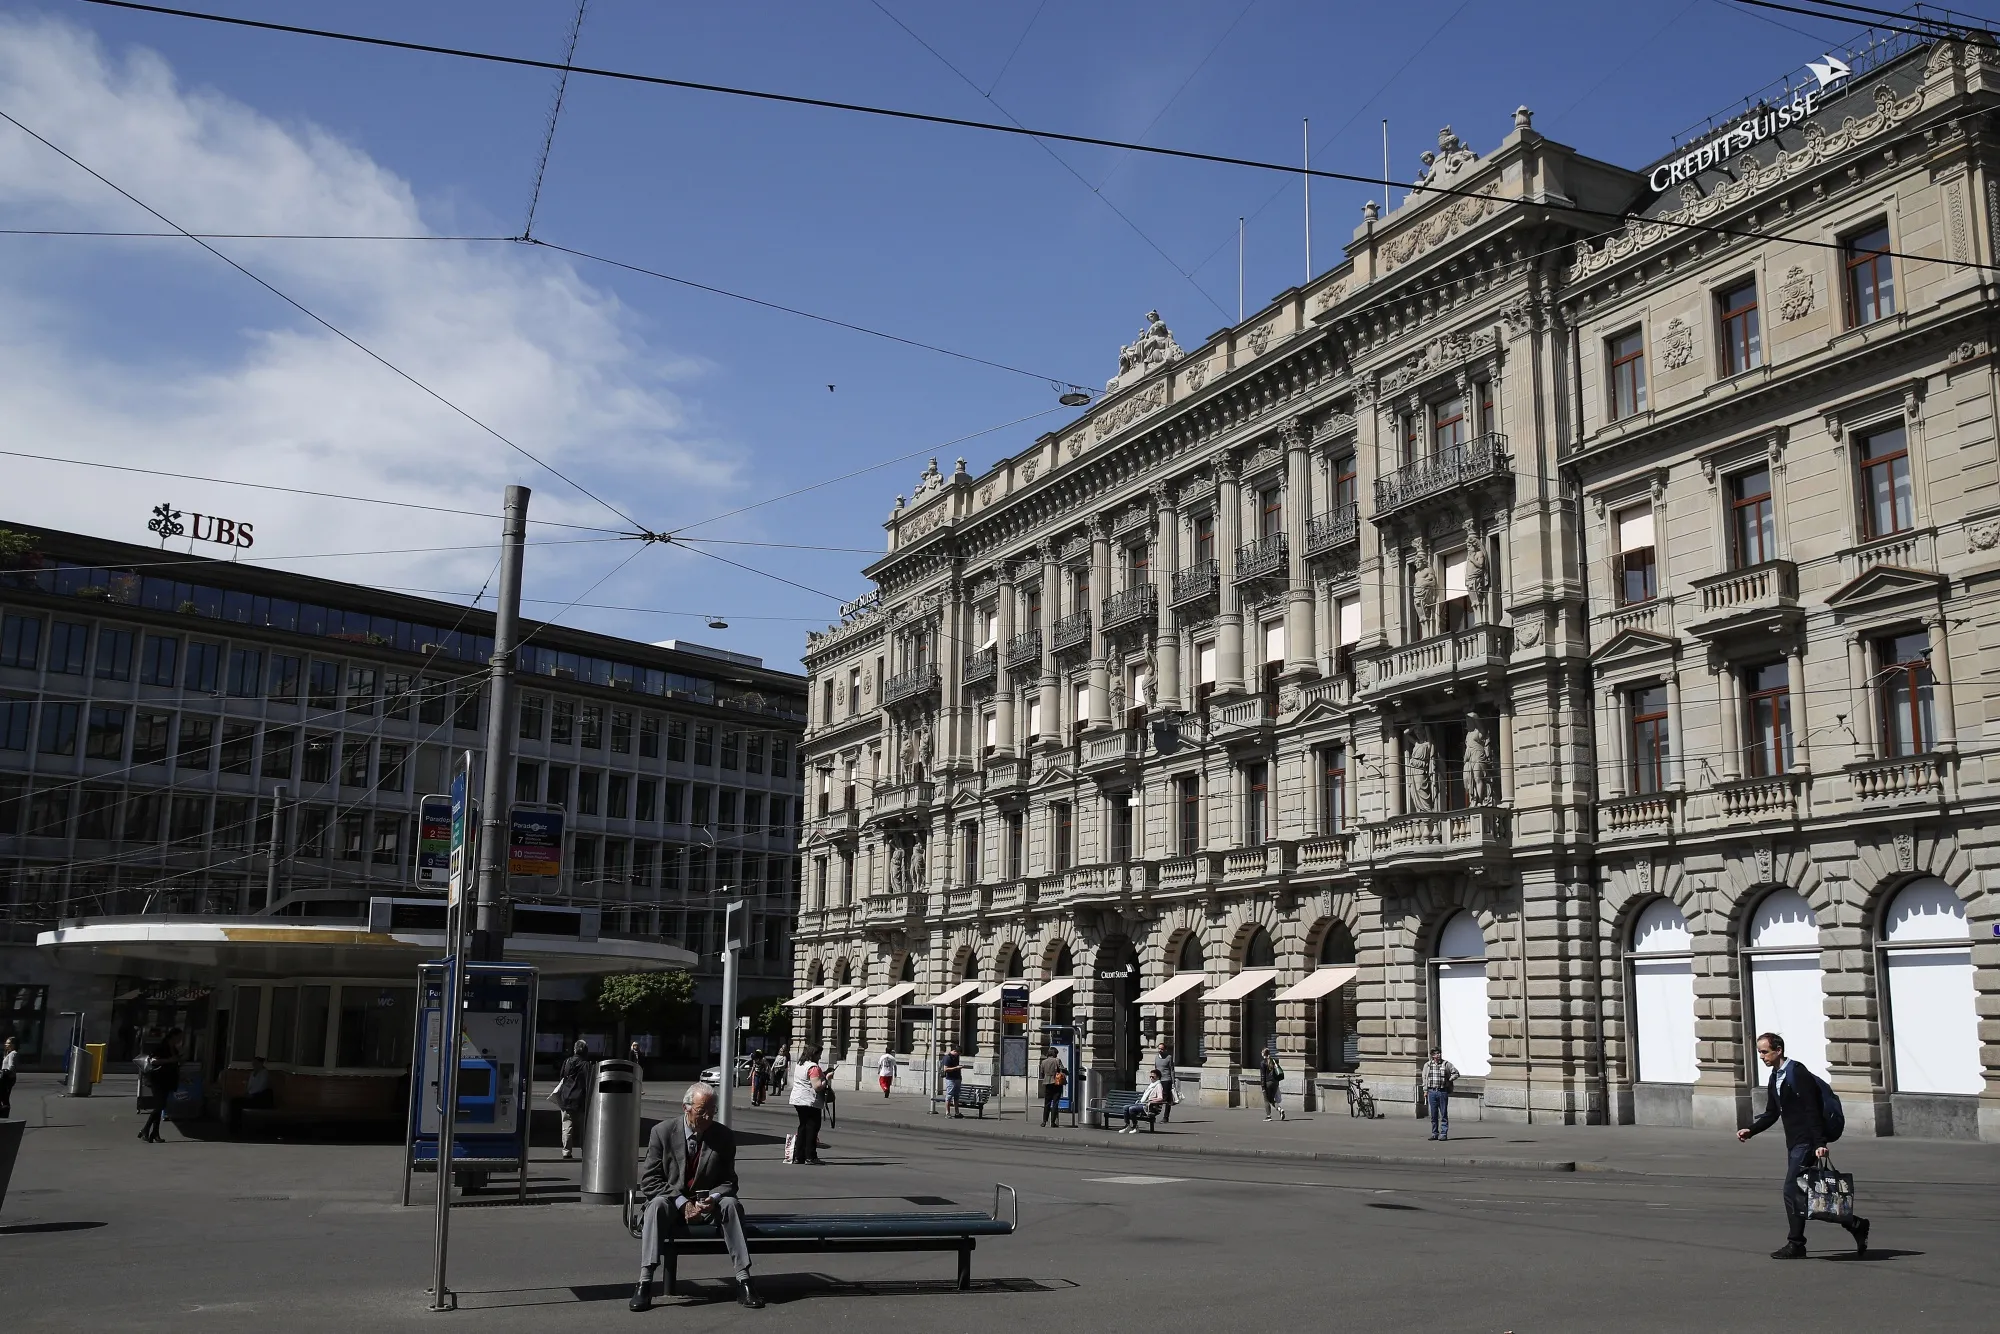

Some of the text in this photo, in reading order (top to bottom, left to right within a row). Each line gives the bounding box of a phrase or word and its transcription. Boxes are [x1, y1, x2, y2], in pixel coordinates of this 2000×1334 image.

[1650, 90, 1819, 192] CREDIT SUISSE
[193, 512, 254, 548] UBS
[429, 829, 436, 838] 2
[518, 836, 524, 845] 7
[514, 850, 522, 858] 10
[427, 858, 434, 866] 9
[512, 864, 521, 872] 13
[377, 997, 395, 1007] WC
